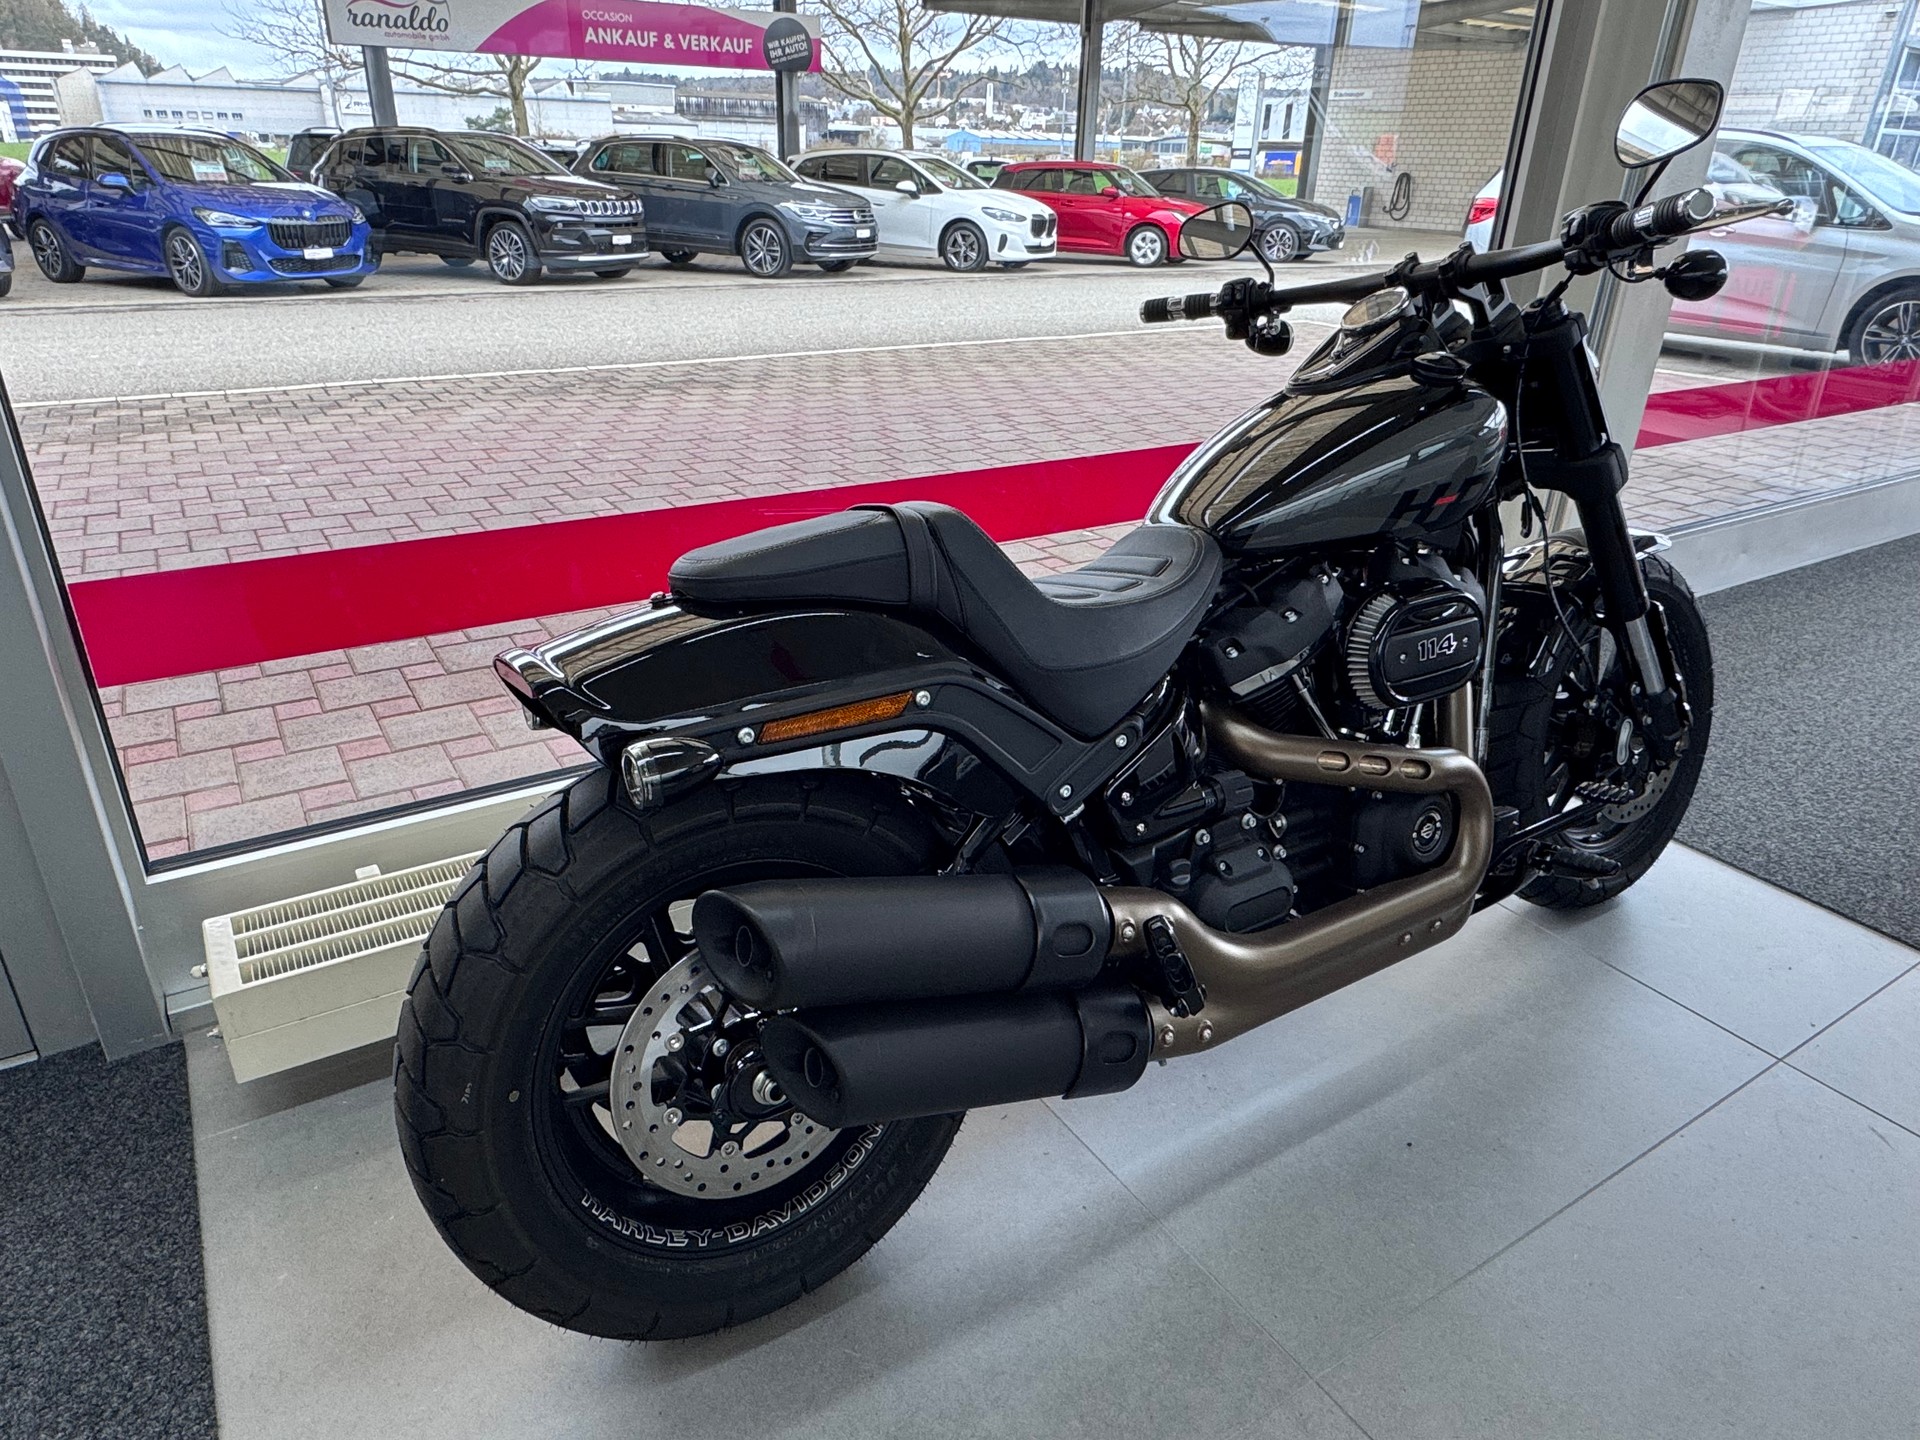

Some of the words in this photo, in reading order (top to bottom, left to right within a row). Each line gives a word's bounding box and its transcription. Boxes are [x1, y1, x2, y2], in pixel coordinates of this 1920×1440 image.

[347, 5, 449, 32] ranaldo
[582, 10, 633, 23] OCCASION
[585, 27, 658, 48] ANKAUF
[663, 33, 675, 49] &
[678, 33, 753, 54] VERKAUF
[767, 40, 780, 49] WIR
[780, 33, 806, 46] KAUFEN
[770, 48, 783, 59] IHR
[1418, 632, 1458, 661] 114
[581, 1124, 883, 1247] HARLEY-DAVIDSON
